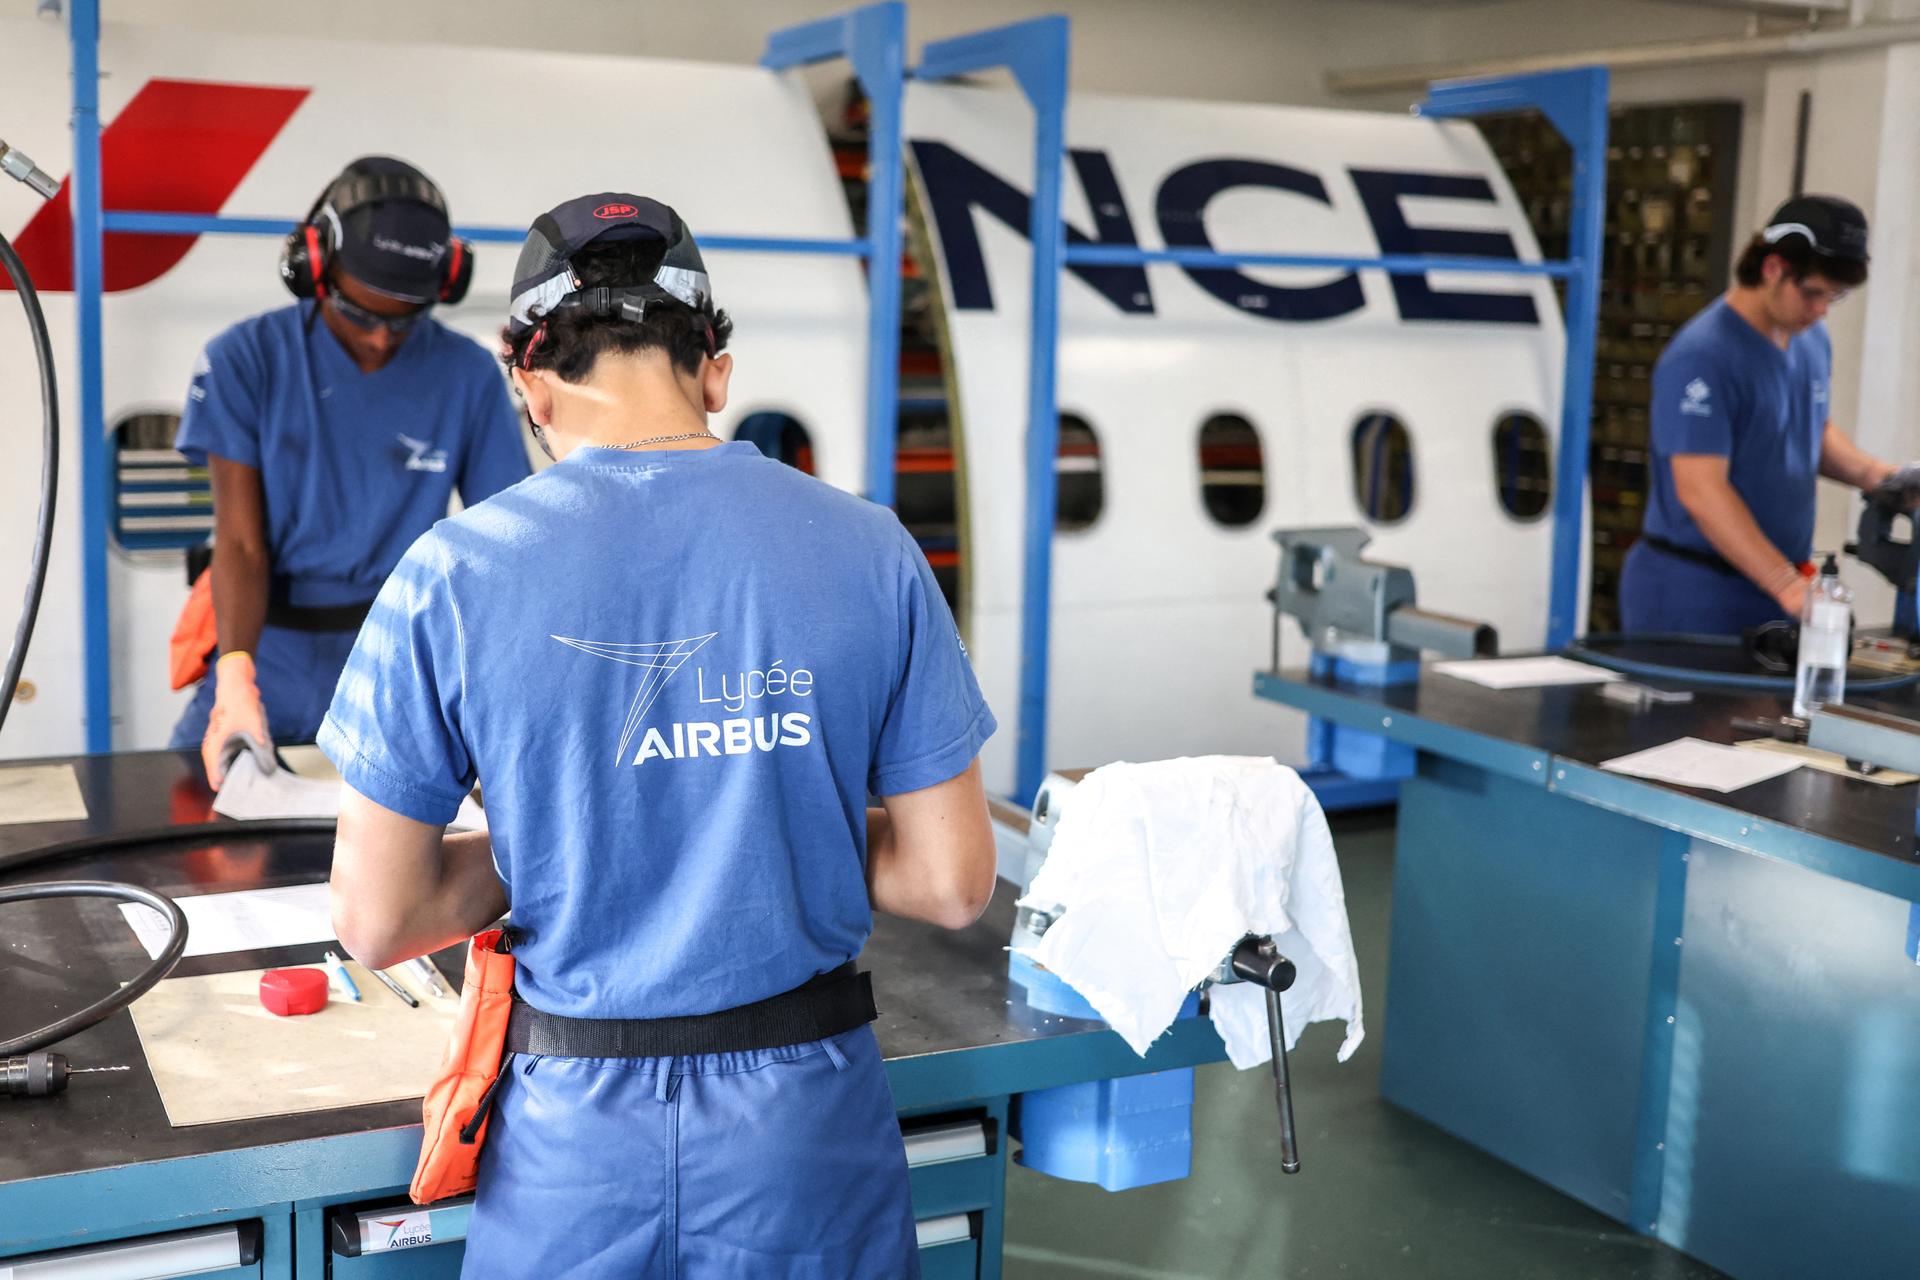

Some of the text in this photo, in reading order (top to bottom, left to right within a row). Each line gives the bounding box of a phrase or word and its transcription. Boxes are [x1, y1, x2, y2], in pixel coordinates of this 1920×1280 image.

[601, 205, 631, 217] JSP
[911, 139, 1540, 324] NCE
[698, 659, 813, 712] Lycée
[632, 712, 812, 766] AIRBUS
[390, 1234, 432, 1248] AIRBUS
